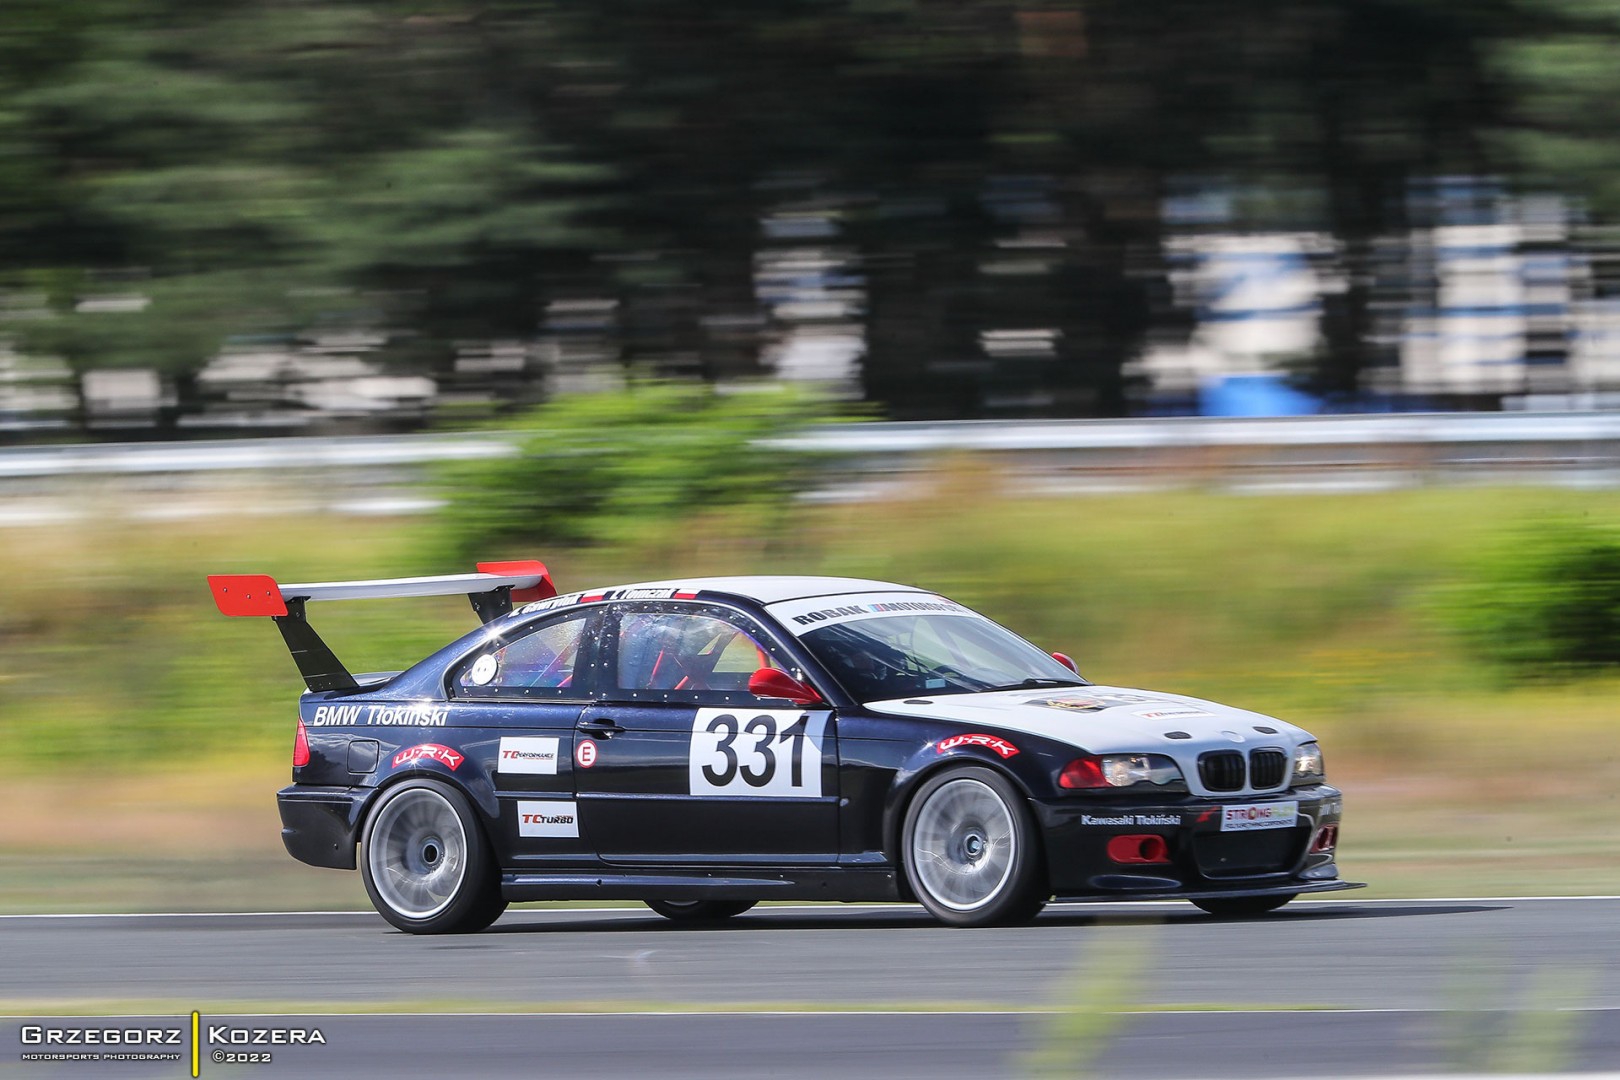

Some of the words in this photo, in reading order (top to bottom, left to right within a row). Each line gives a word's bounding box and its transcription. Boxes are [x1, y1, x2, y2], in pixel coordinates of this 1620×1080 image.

[792, 605, 868, 625] ROBAK
[313, 705, 362, 727] BMW
[582, 746, 591, 762] E
[701, 713, 811, 788] 331
[1081, 814, 1134, 826] Kawasaki
